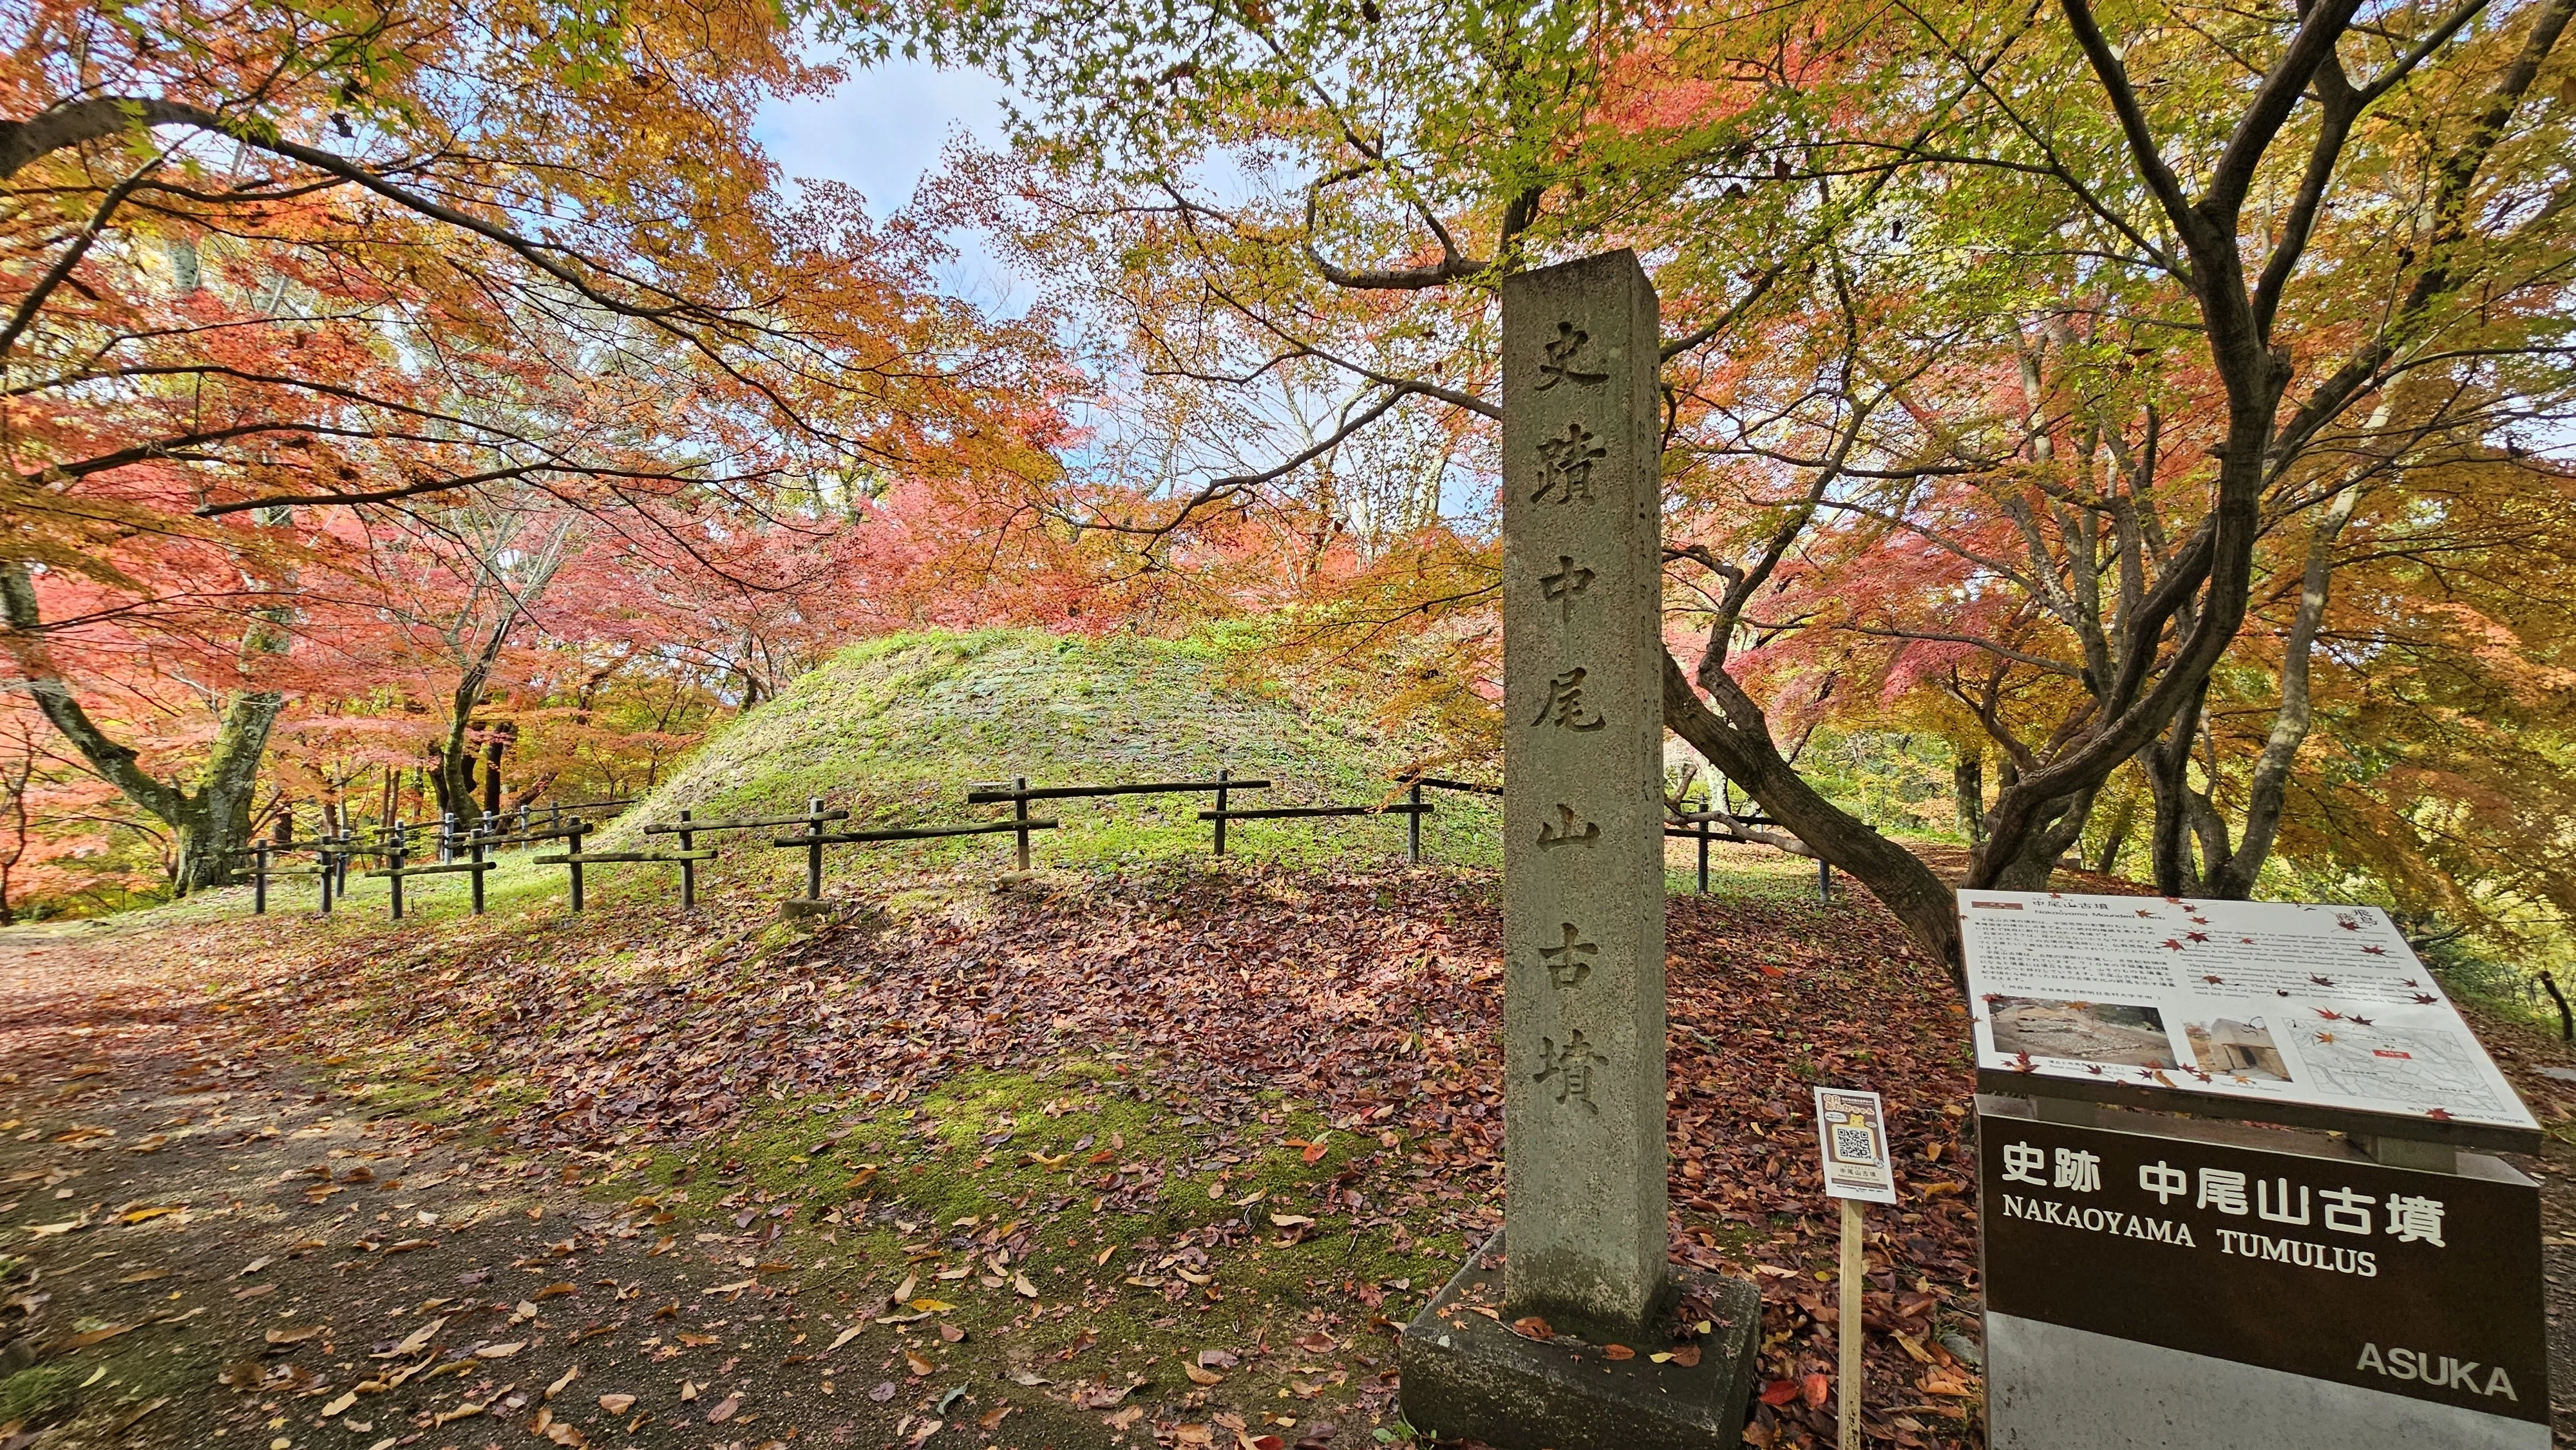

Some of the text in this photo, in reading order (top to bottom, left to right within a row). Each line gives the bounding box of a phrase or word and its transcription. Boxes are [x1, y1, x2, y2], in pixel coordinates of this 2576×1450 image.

[1530, 320, 1609, 1116] 史蹟中尾山古墳
[2032, 899, 2110, 910] 中尾山古墳
[1824, 1094, 1841, 1103] QR
[2485, 1114, 2527, 1124] Village
[2001, 1141, 2447, 1248] 史跡 中尾山古墳
[2002, 1193, 2378, 1279] NAKAOYAMA TUMULUS
[2356, 1341, 2519, 1402] ASUKA
